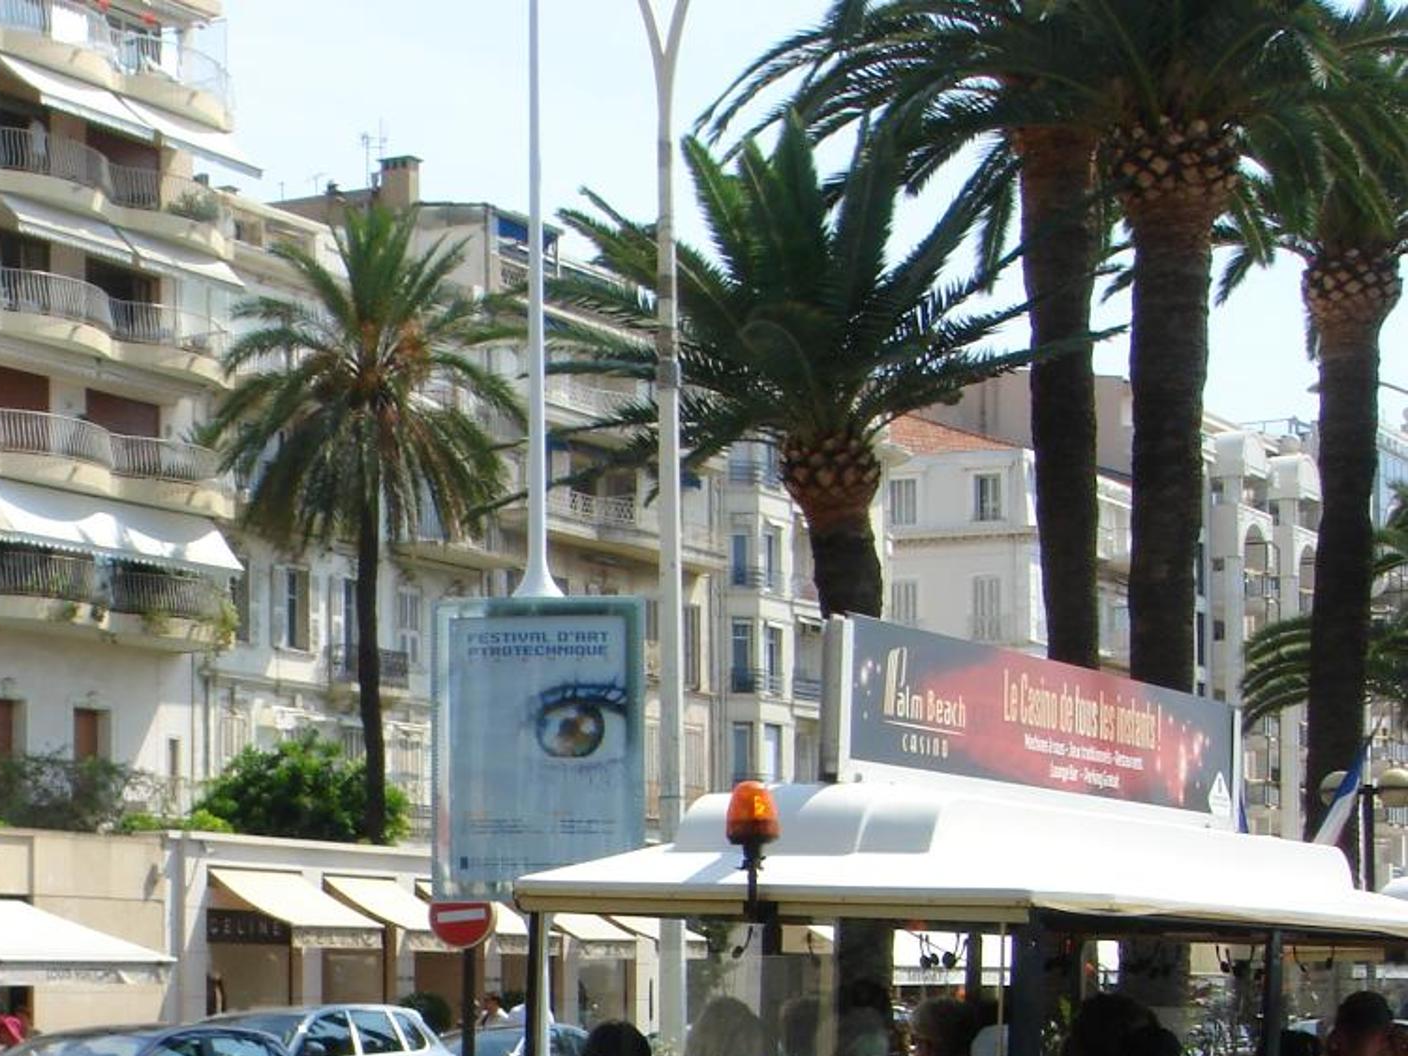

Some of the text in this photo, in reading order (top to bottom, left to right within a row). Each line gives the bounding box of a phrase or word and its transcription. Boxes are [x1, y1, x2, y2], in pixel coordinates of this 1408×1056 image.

[467, 630, 609, 644] FESTIVAL D'ART
[927, 690, 966, 728] Beach
[1004, 668, 1017, 721] Le
[1020, 673, 1058, 730] Casino
[1059, 682, 1073, 733] de
[1075, 685, 1098, 738] tous
[1100, 691, 1115, 742] les
[1117, 696, 1156, 750] instants
[902, 733, 948, 758] casino
